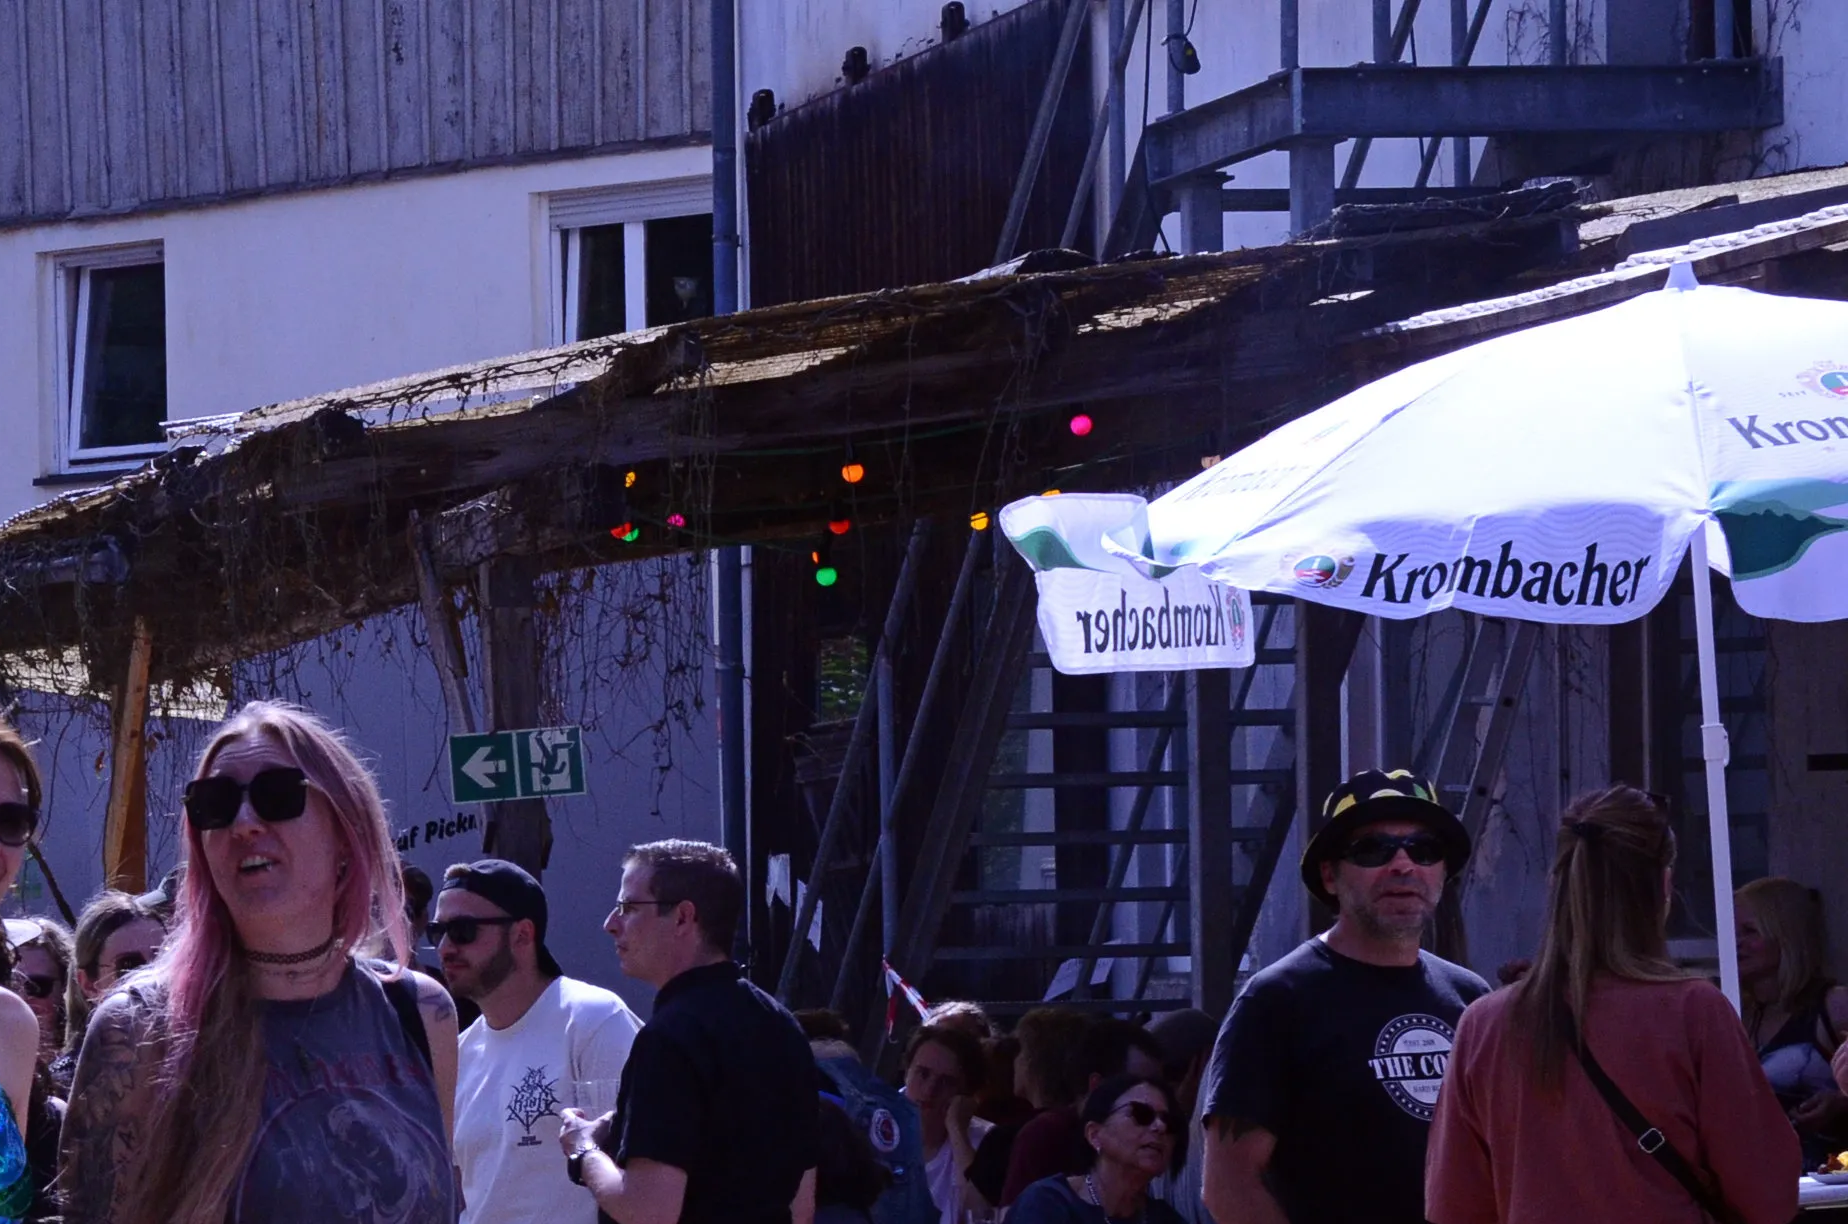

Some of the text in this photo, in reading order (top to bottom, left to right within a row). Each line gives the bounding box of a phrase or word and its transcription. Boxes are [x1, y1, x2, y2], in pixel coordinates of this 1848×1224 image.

[1360, 540, 1651, 607] Krombacher
[1368, 1053, 1449, 1079] THE CO
